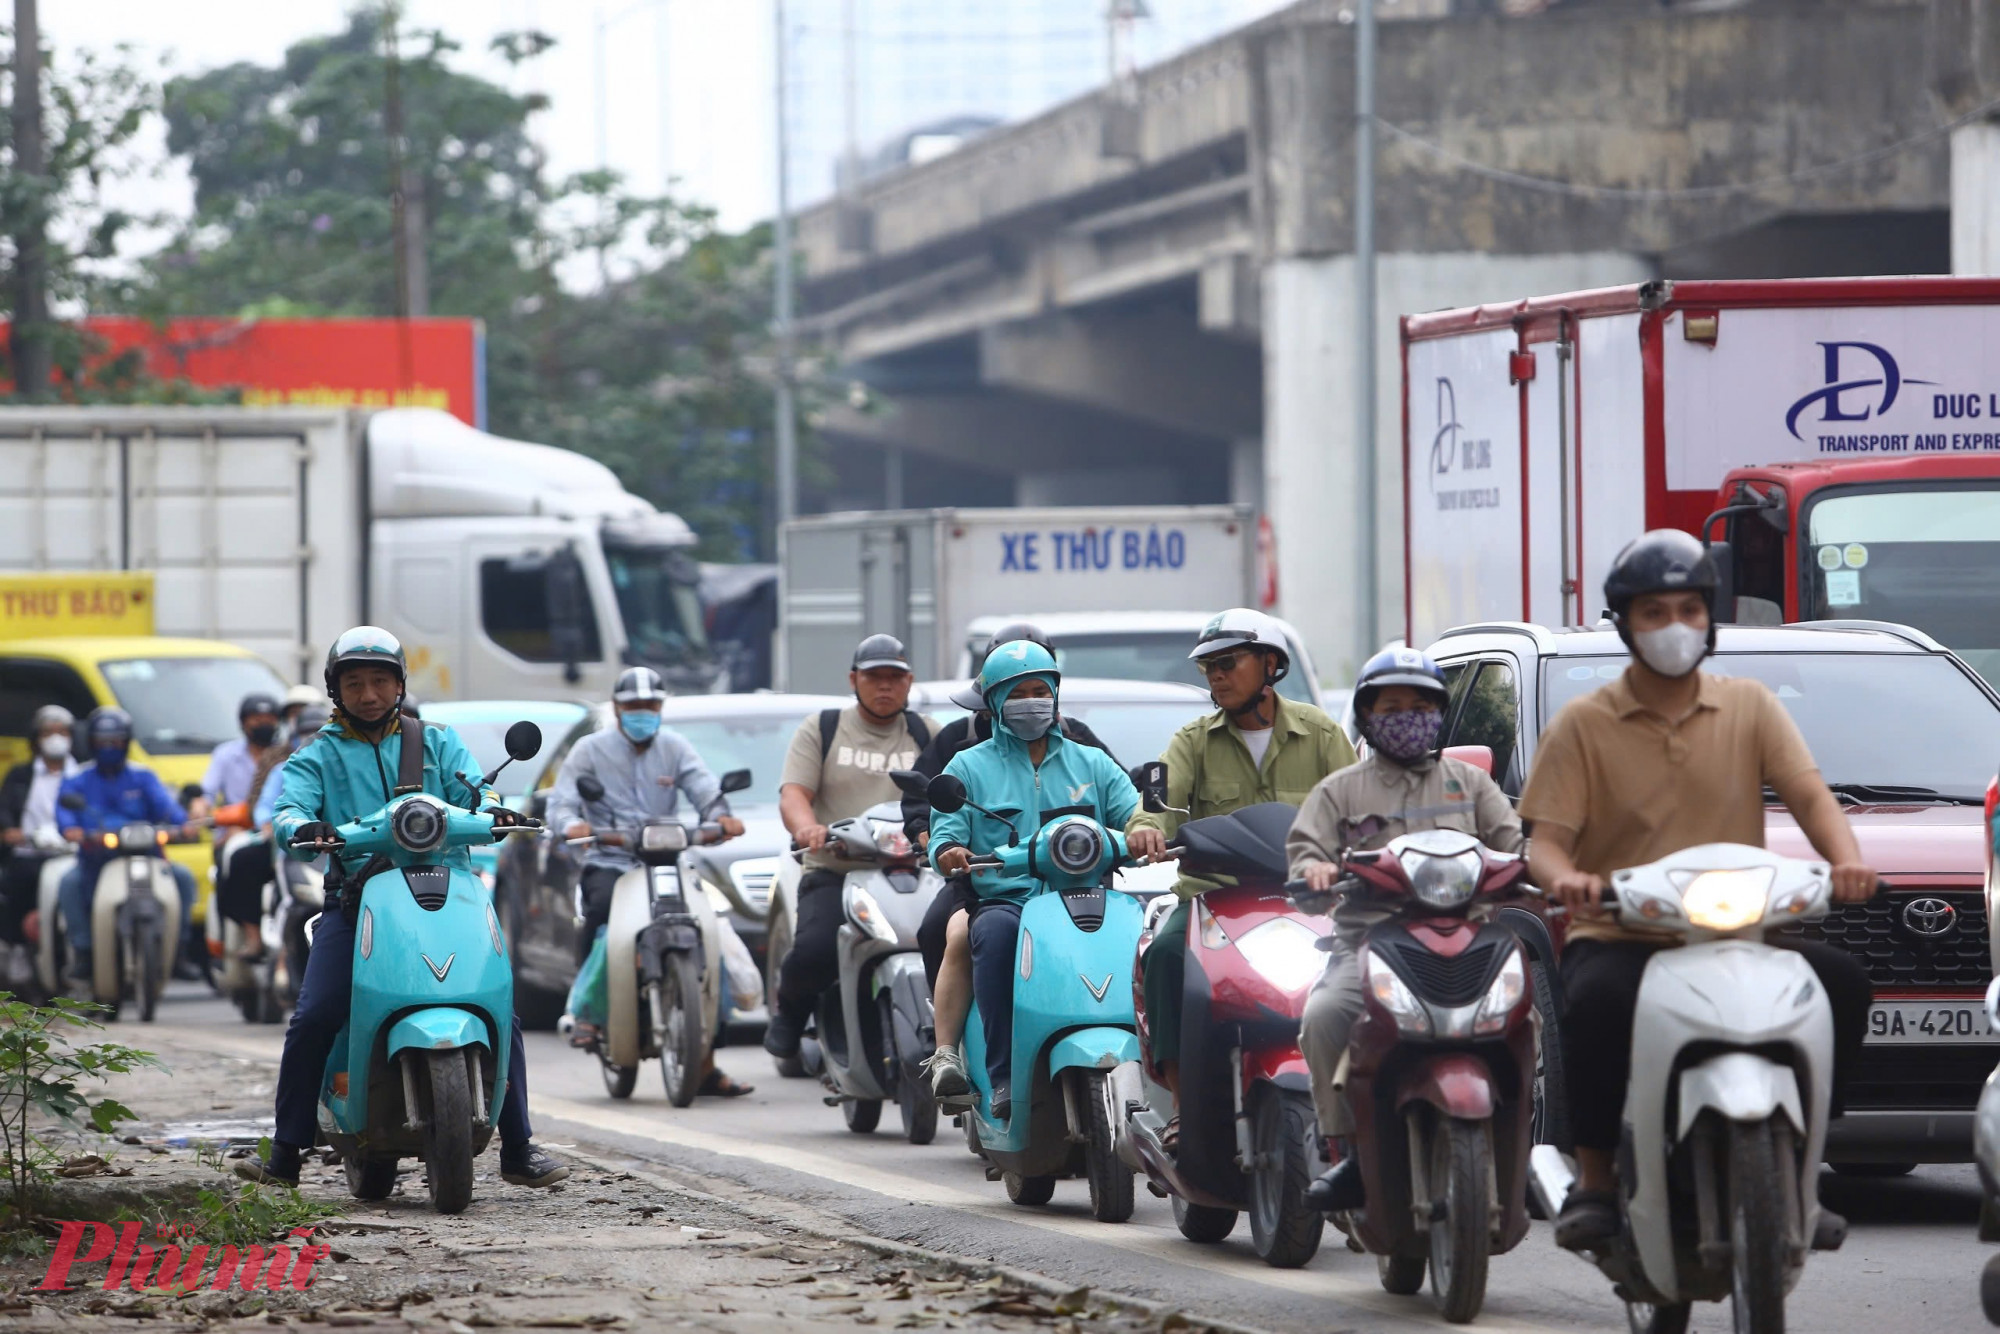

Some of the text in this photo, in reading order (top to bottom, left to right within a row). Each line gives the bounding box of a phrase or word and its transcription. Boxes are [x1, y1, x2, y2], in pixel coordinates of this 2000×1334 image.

[1933, 393, 1981, 419] DUC
[1818, 434, 1910, 452] TRANSPORT
[1914, 434, 1947, 451] AND
[1000, 532, 1039, 571] XE
